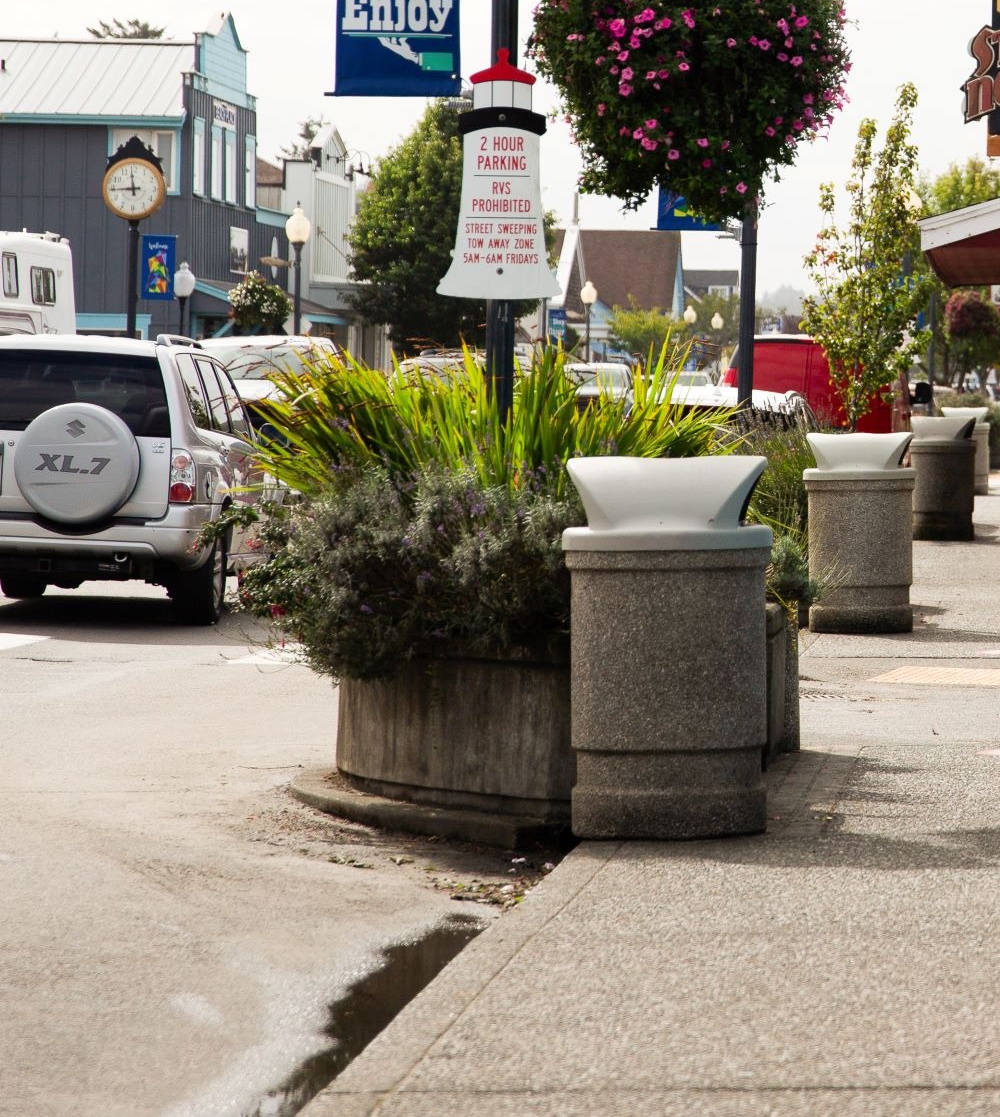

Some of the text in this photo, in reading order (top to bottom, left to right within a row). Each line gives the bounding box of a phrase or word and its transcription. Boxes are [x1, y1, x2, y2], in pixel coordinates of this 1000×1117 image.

[480, 136, 524, 152] 2 HOUR
[477, 155, 527, 171] PARKING
[492, 181, 511, 195] RVS
[472, 199, 531, 213] PROHIBITED
[465, 223, 537, 234] STREET SWEEPING
[467, 238, 535, 249] TOW AWAY ZONE
[463, 253, 539, 264] 5AM-6AM FRIDAYS
